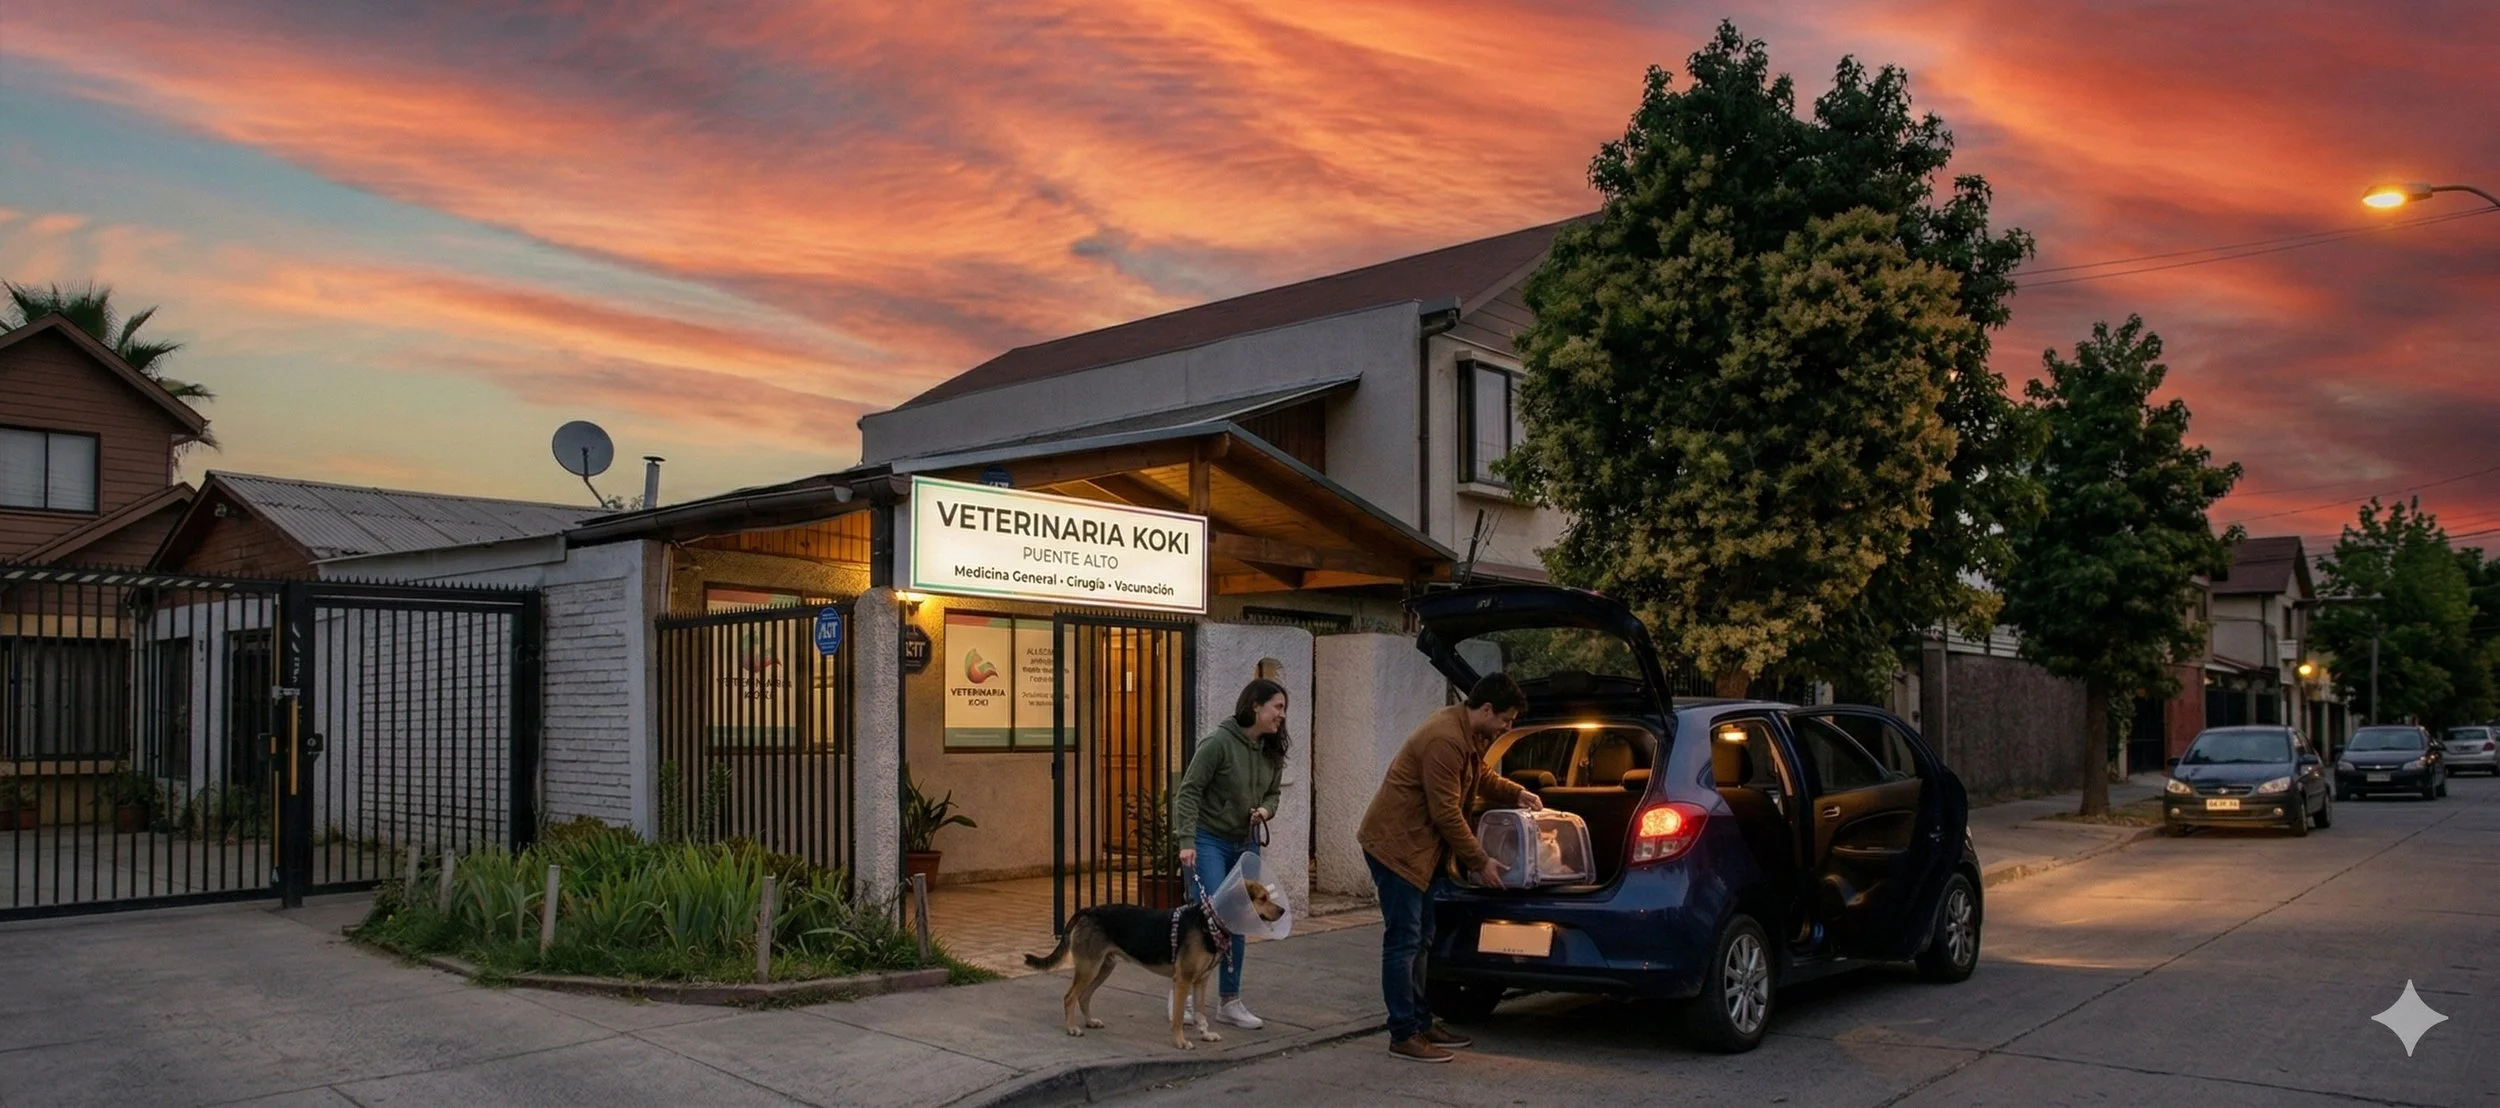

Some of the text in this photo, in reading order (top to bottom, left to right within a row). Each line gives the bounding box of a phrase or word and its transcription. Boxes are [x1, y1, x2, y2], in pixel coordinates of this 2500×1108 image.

[937, 501, 1189, 555] VETERINARIA KOKI
[1023, 546, 1119, 570] PUENTE ALTO
[954, 565, 1174, 596] Medicina General Cirugía Vacunación
[950, 687, 1007, 697] VETERINARIA
[968, 698, 989, 707] KOKI
